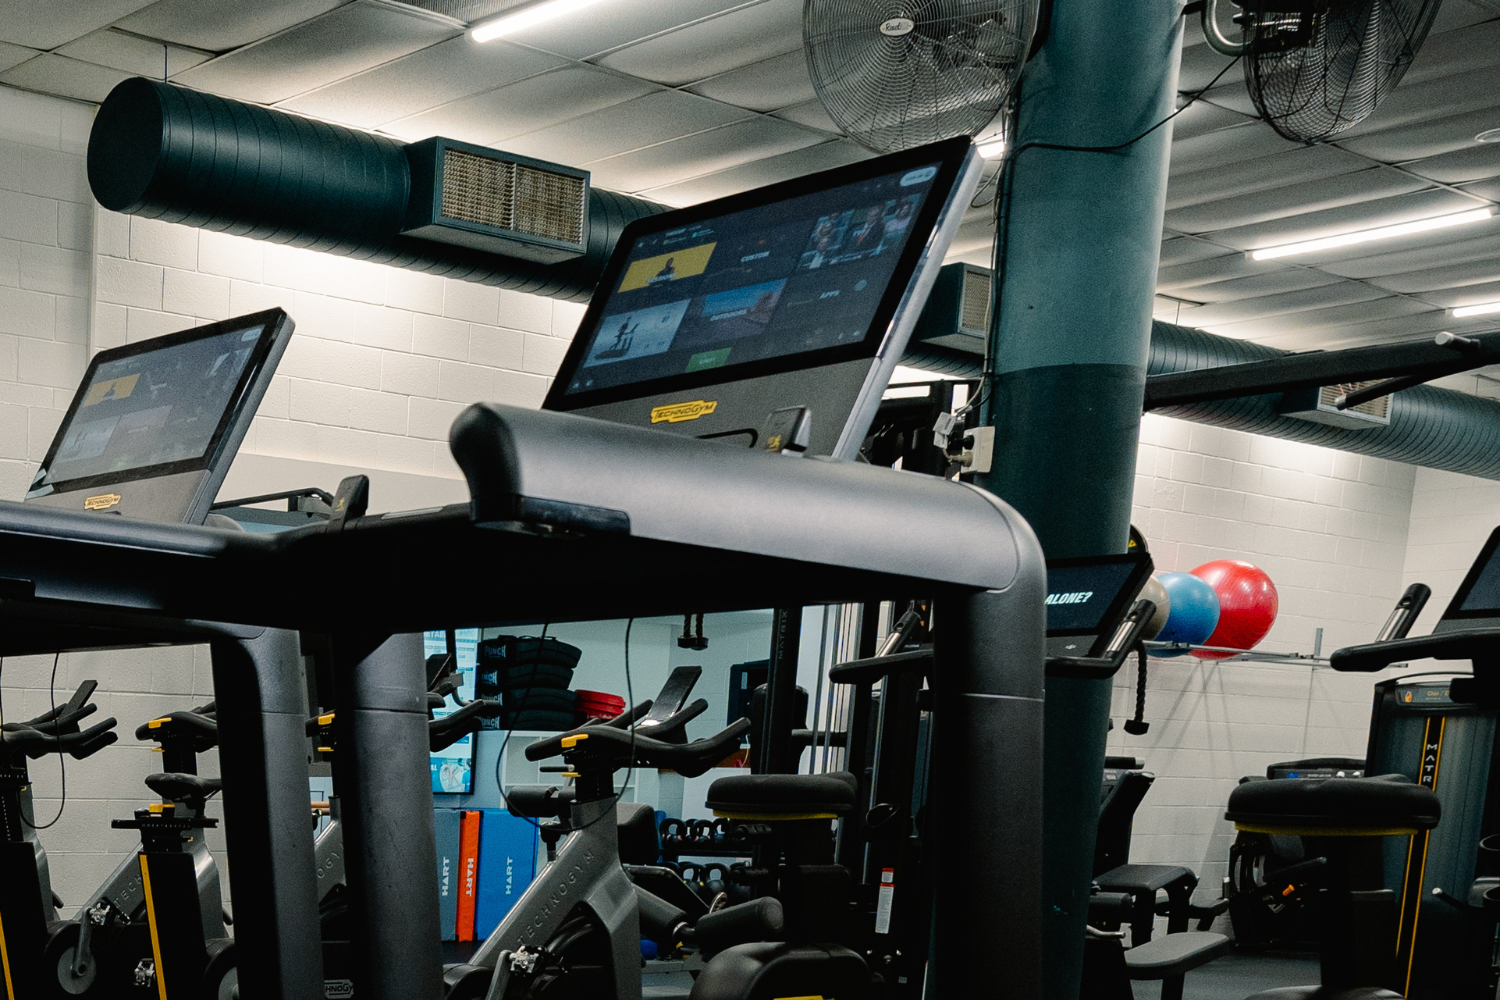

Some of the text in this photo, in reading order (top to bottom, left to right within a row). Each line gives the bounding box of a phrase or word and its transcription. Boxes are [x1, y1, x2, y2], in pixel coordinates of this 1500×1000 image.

[654, 403, 713, 420] TECHNOGYM
[1044, 591, 1094, 606] ALONE?
[485, 644, 506, 658] PUNCH
[1422, 743, 1439, 783] MATR
[441, 856, 450, 897] HART
[465, 857, 475, 897] HART
[505, 856, 514, 895] HART
